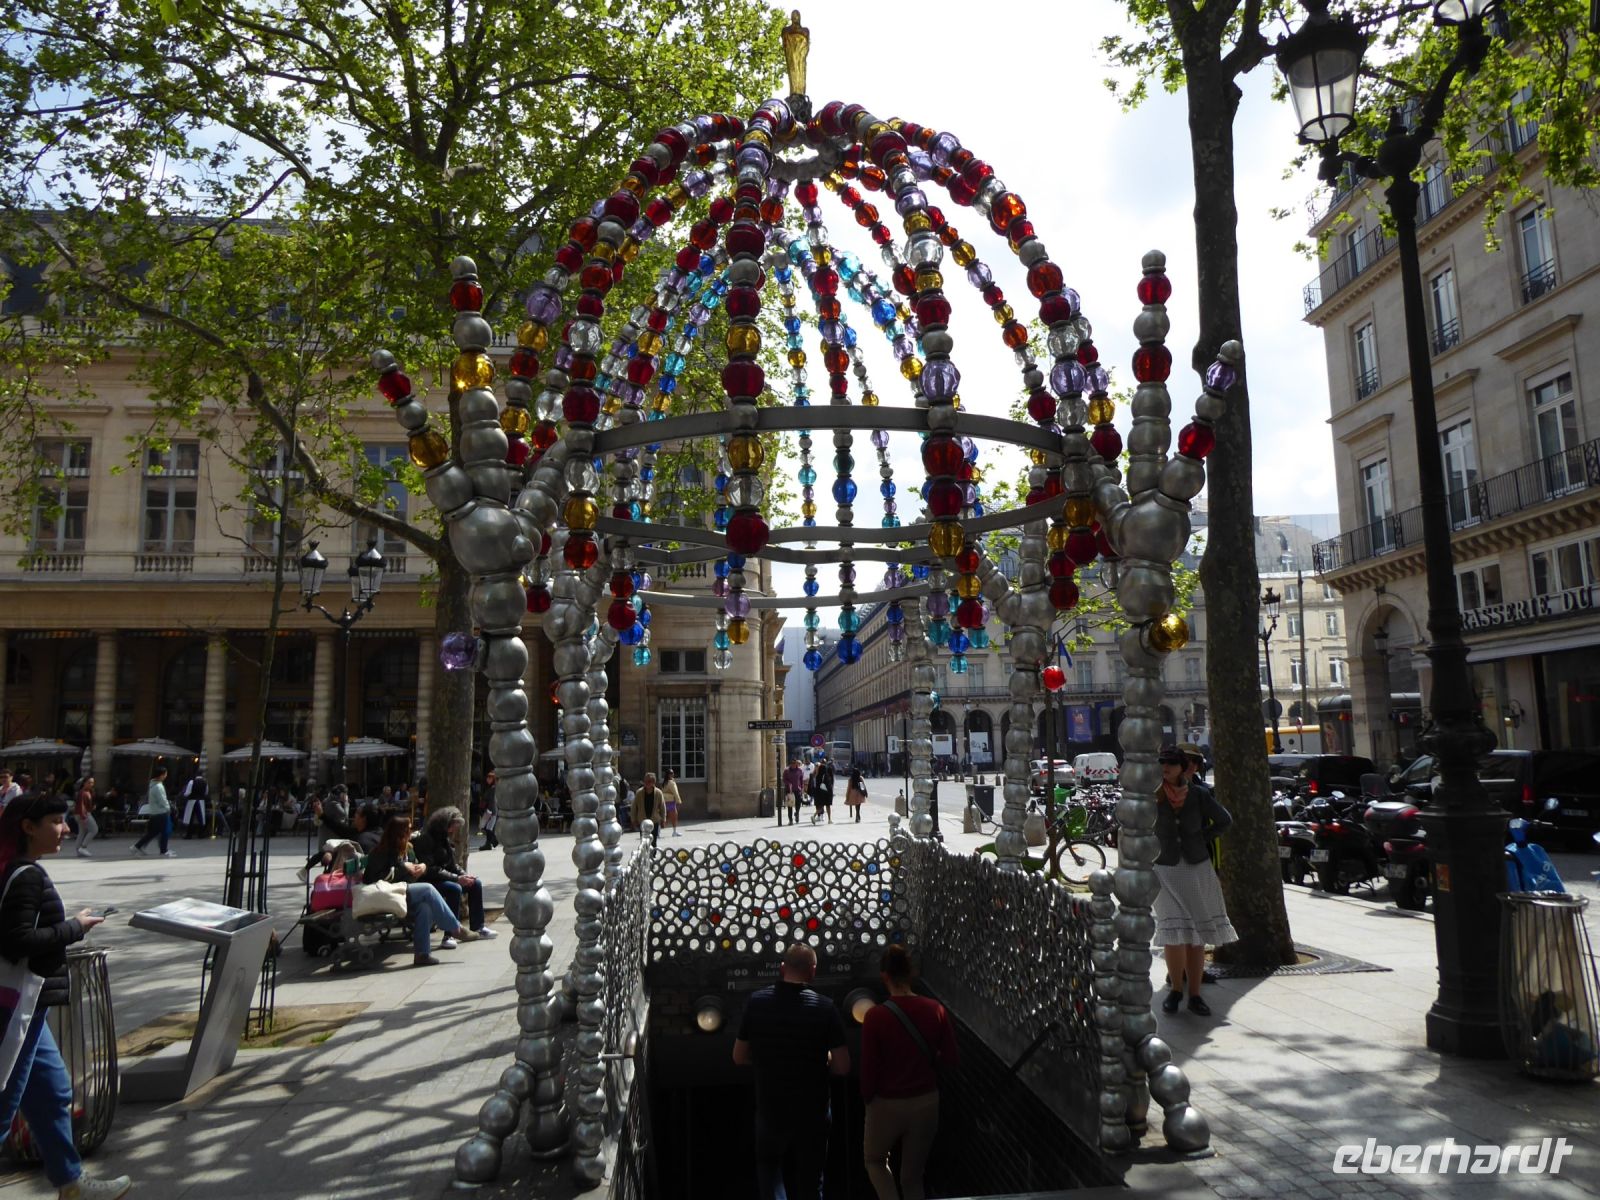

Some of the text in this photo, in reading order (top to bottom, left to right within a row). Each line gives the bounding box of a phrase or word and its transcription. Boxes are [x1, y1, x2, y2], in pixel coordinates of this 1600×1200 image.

[1461, 587, 1592, 630] RASSERIE DU
[765, 961, 781, 969] Pala
